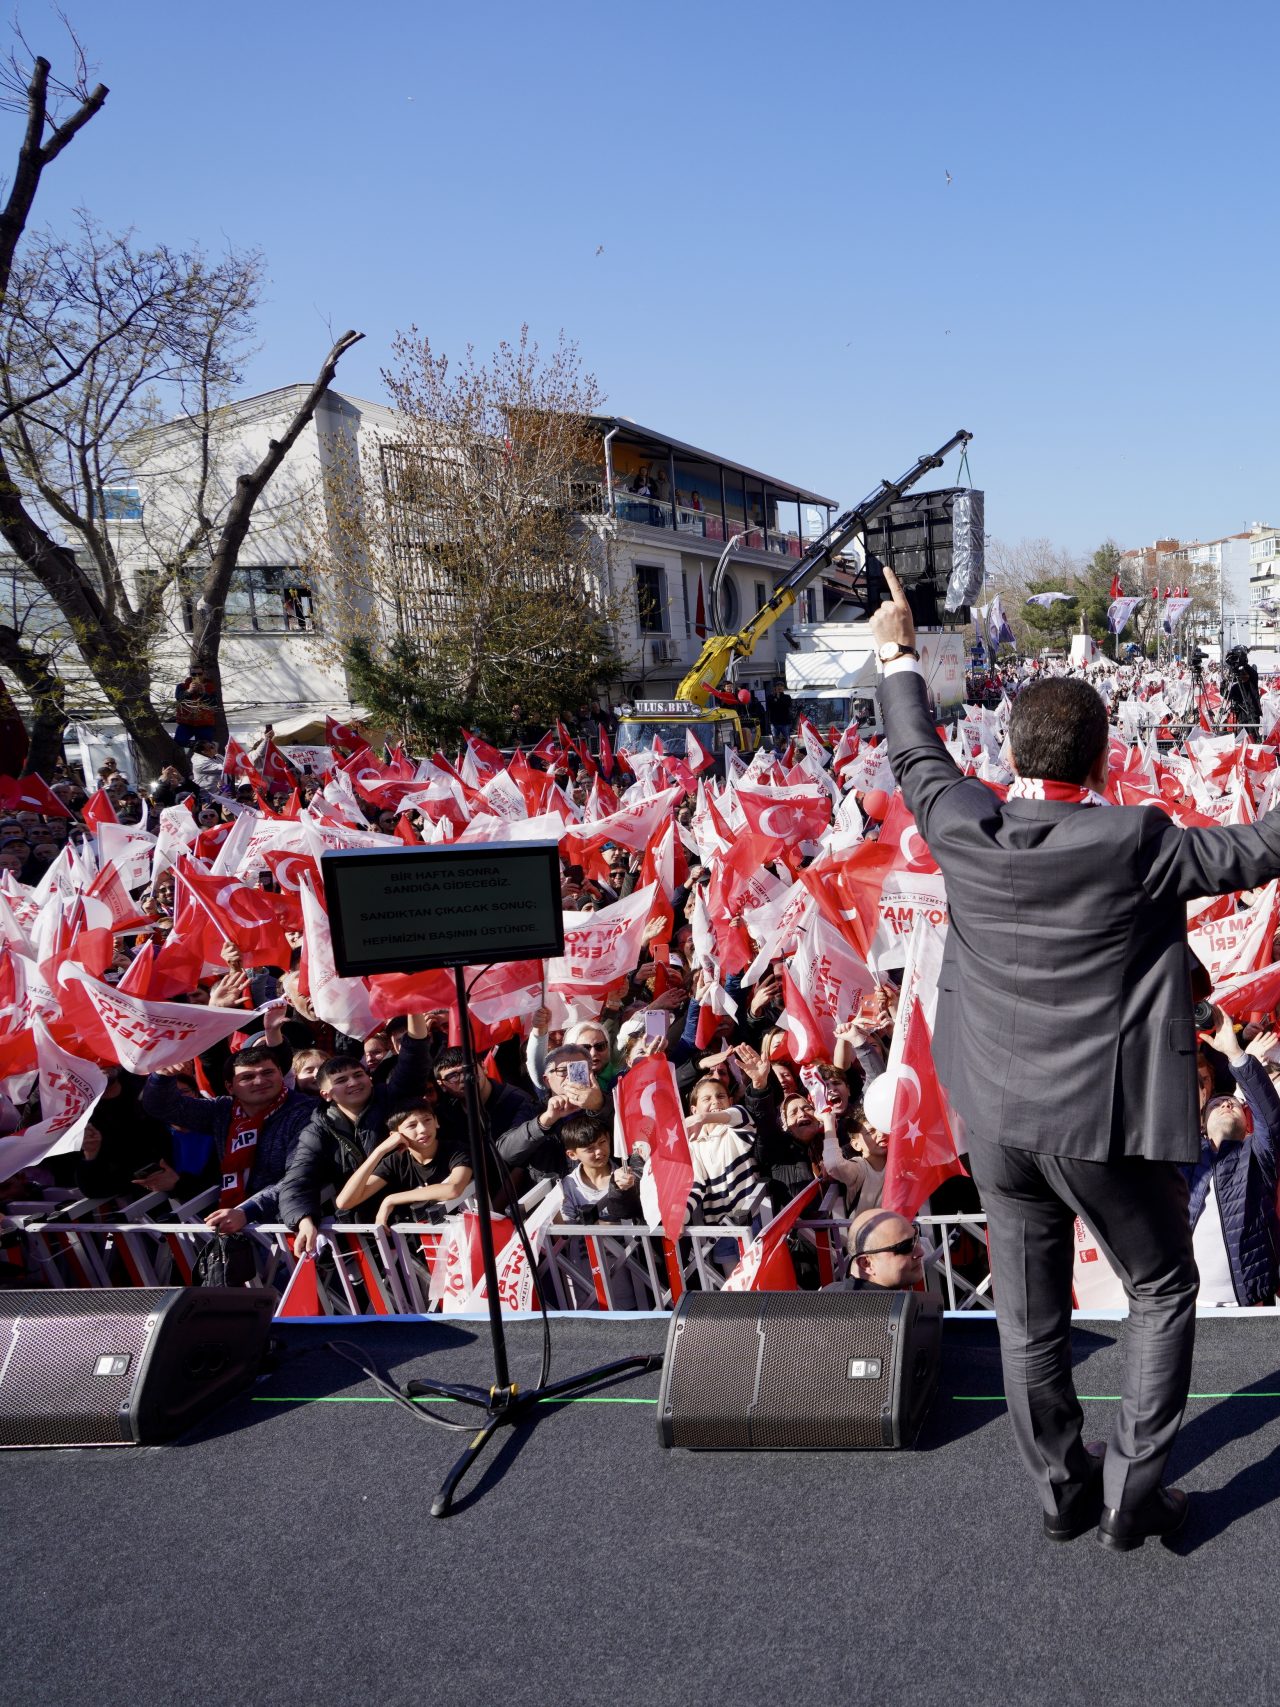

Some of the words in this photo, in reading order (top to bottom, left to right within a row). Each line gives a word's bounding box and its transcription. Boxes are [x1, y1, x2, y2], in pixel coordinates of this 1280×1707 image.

[636, 702, 689, 712] ULUS.BEY
[391, 869, 413, 882] BİR
[416, 868, 454, 880] HAFTA
[457, 867, 499, 878] SONRA
[384, 880, 440, 895] SANDIĞA
[442, 877, 511, 890] GİDECEĞİZ.
[360, 908, 432, 922] SANDIKTAN
[435, 903, 489, 917] ÇIKACAK
[362, 932, 426, 946] HEPİMİZİN
[429, 928, 477, 942] BAŞININ
[480, 923, 539, 936] ÜSTÜNDE.
[508, 1281, 519, 1311] YO
